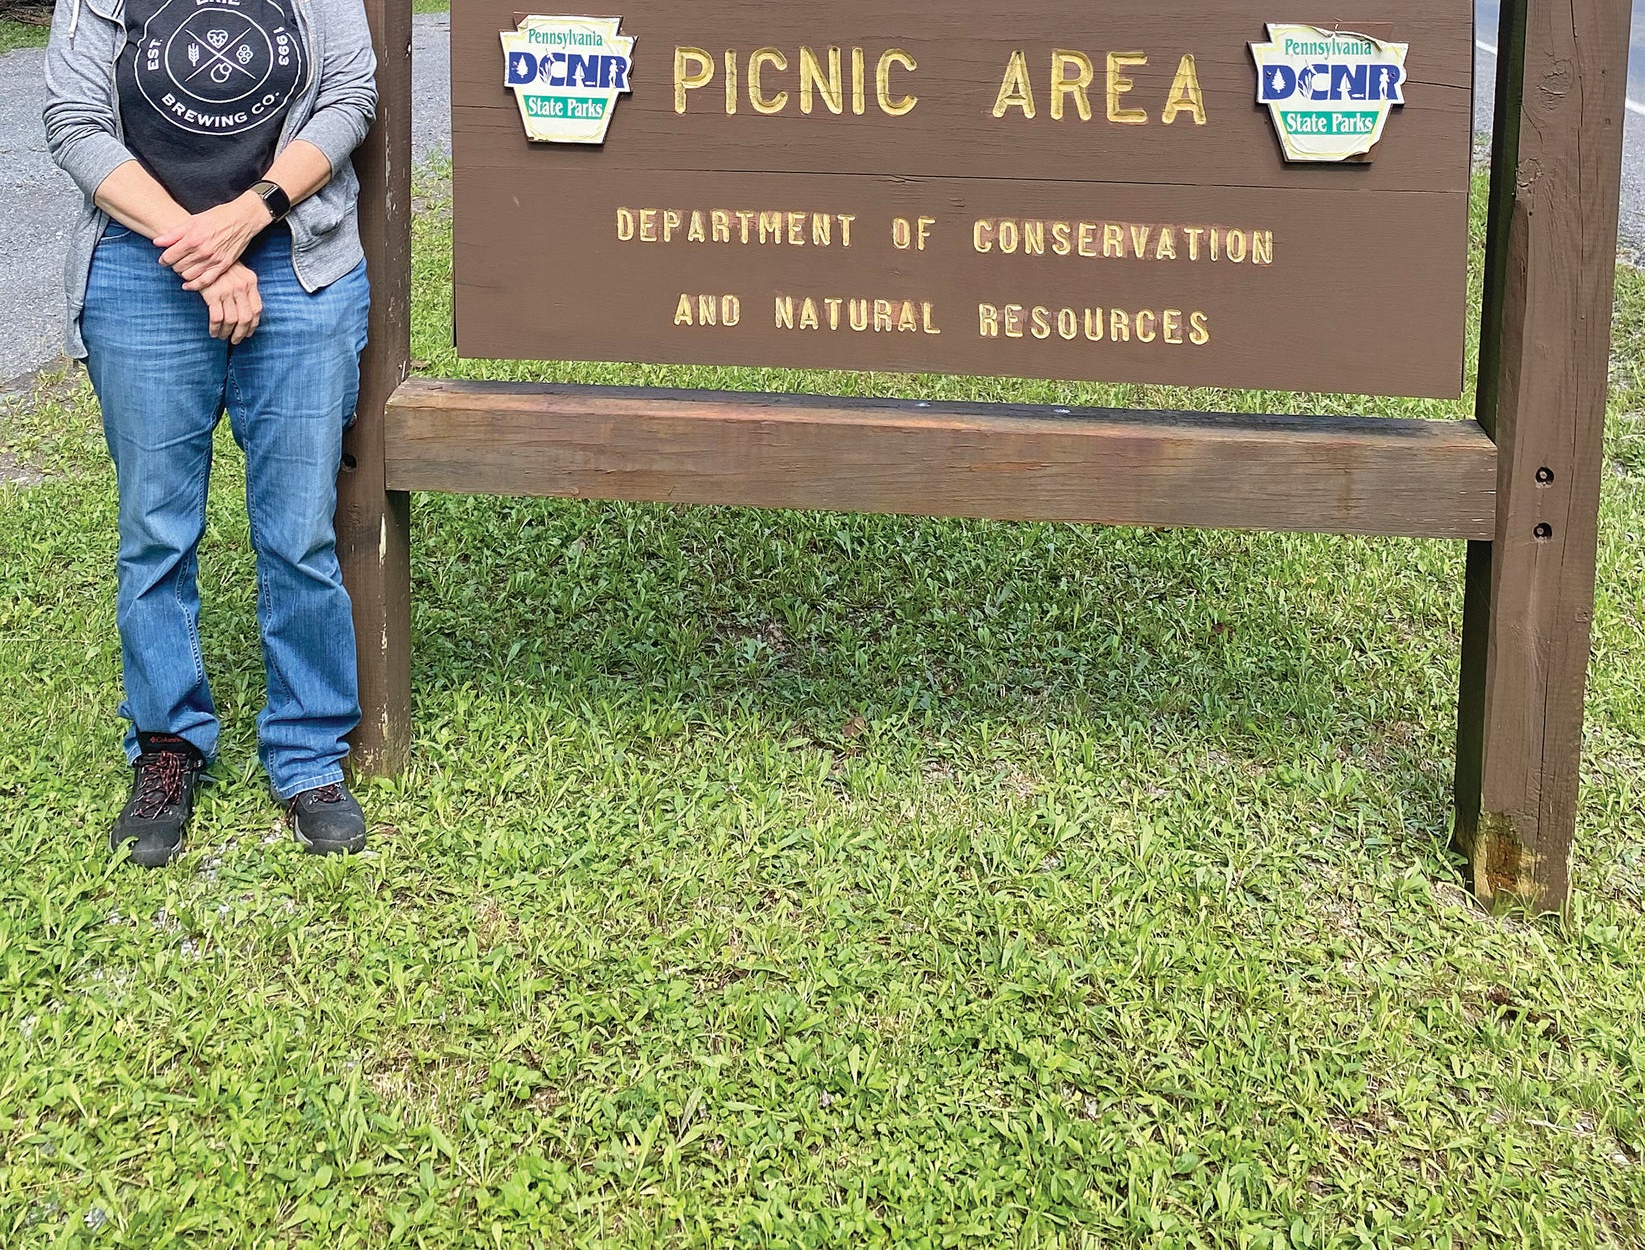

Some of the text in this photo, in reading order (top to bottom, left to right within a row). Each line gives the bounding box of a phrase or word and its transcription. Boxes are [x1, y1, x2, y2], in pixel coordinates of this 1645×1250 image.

[147, 37, 163, 71] EST.
[272, 26, 290, 67] 1993
[528, 29, 603, 50] Pennsylvania
[1285, 37, 1372, 61] Pennsylvania
[508, 51, 628, 89] DCNR
[673, 46, 1207, 125] PICNIC AREA
[1262, 63, 1401, 101] DCNR
[161, 90, 281, 128] BREWING CO.
[528, 96, 603, 117] State Parks
[1286, 113, 1373, 133] State Parks
[616, 207, 1274, 265] DEPARTMENT OF CONSERVATION
[673, 293, 1210, 345] AND NATURAL RESOURCES
